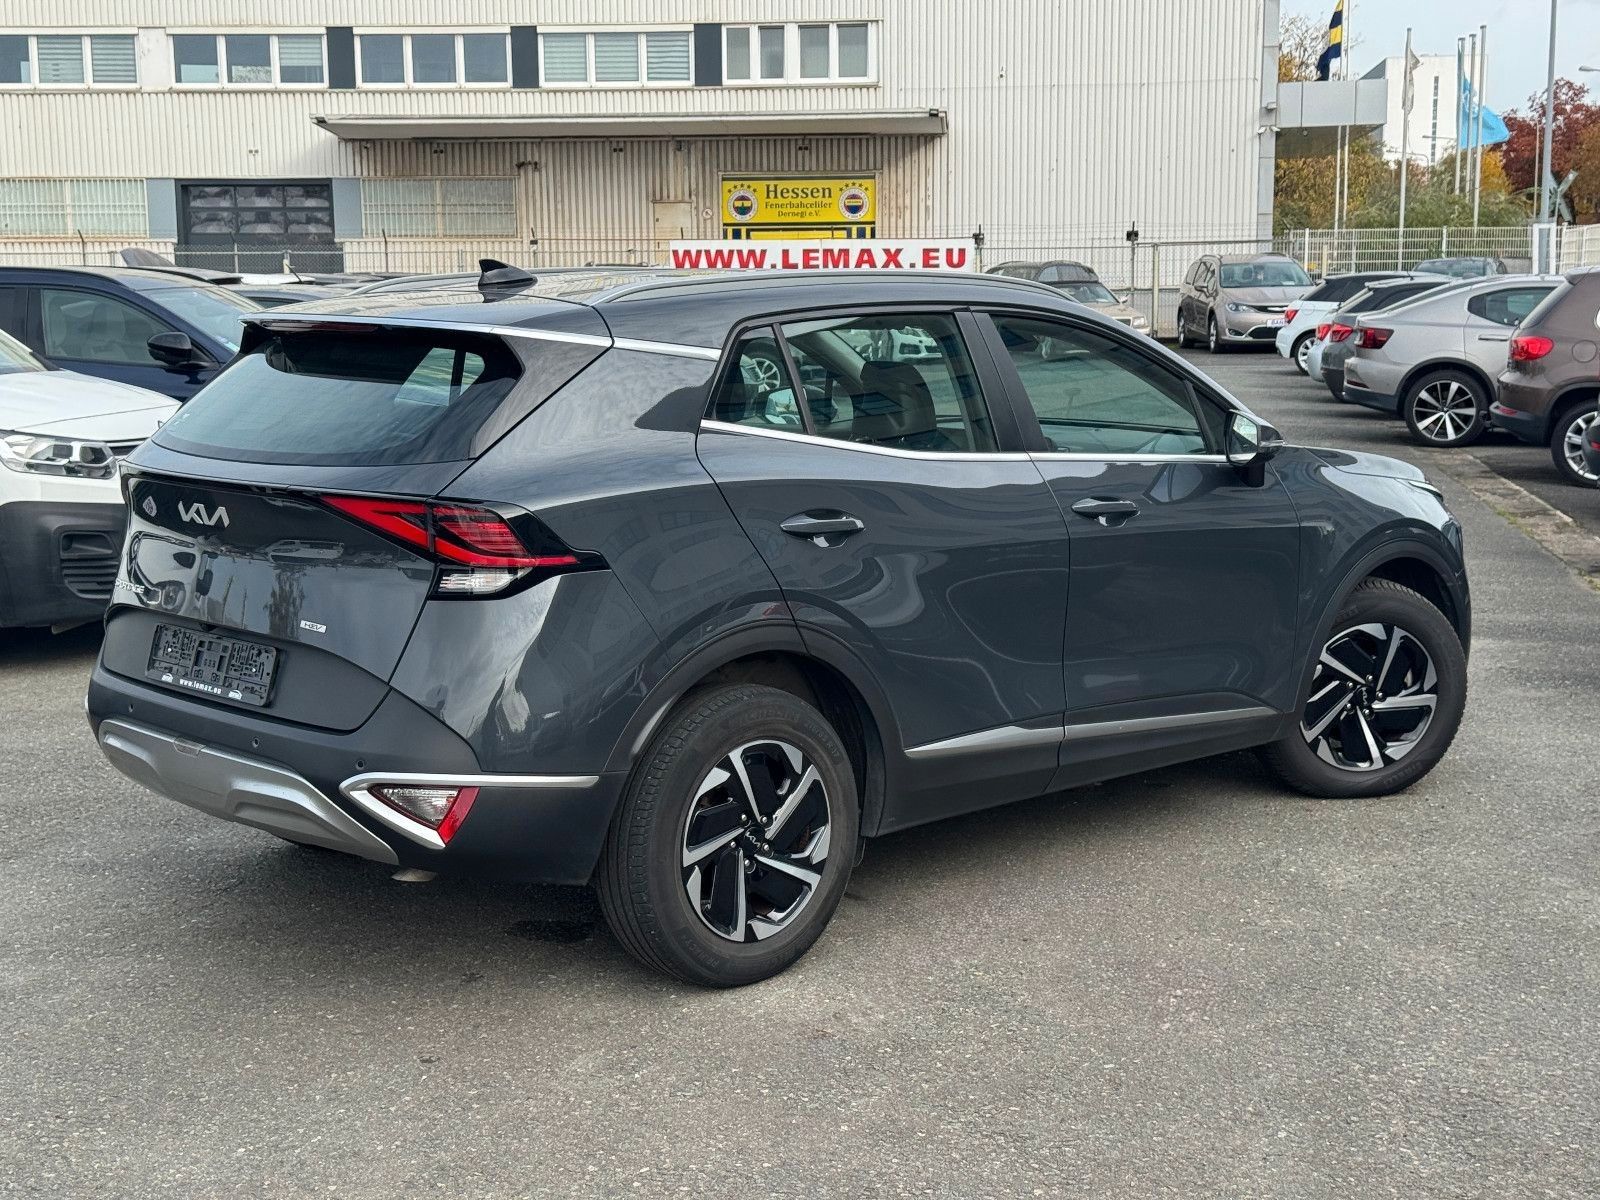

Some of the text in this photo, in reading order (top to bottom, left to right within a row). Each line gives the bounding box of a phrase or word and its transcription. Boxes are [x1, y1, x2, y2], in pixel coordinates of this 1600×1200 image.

[765, 184, 832, 199] Hessen
[671, 247, 967, 269] WWW.LEMAX.EU
[177, 500, 230, 528] KIA
